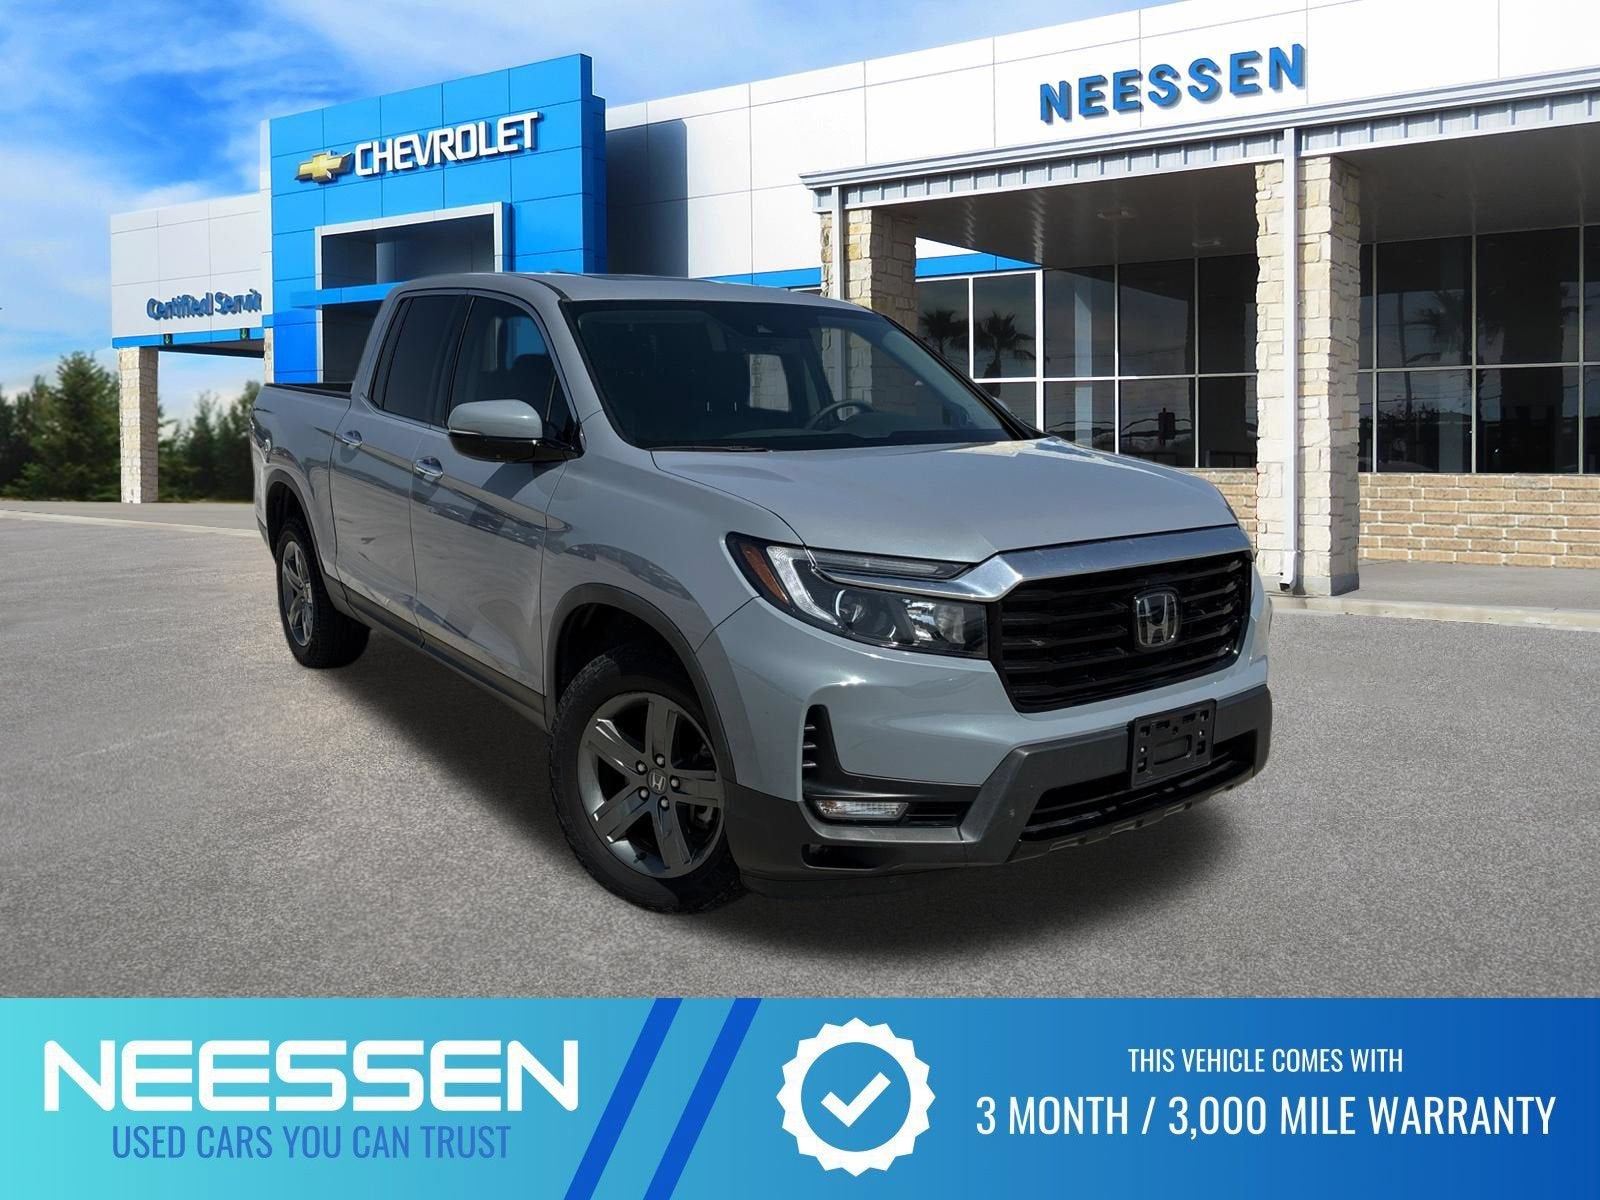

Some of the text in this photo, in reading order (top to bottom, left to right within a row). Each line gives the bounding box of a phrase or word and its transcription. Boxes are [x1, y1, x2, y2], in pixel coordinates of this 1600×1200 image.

[1040, 44, 1305, 123] NEESSEN
[354, 111, 541, 178] CHEVROLET
[147, 293, 213, 320] Certified
